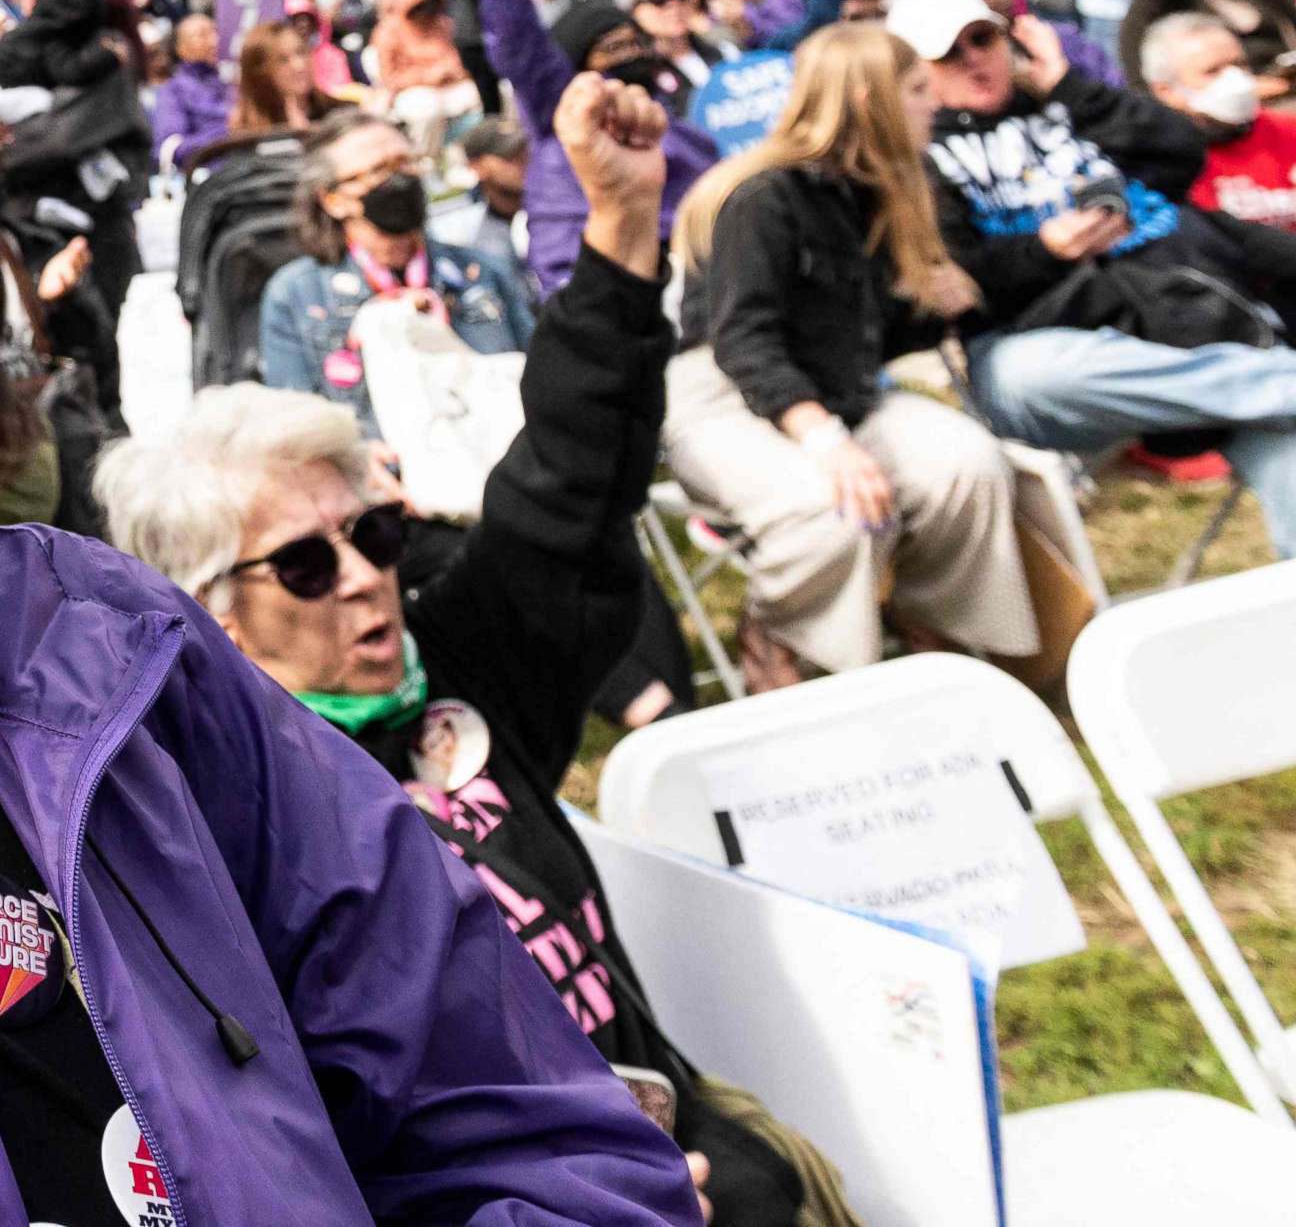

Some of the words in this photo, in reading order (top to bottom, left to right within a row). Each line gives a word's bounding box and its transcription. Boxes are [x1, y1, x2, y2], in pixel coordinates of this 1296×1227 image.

[738, 778, 877, 823] RESERVED
[882, 761, 933, 791] FOR
[825, 798, 936, 843] SEATING
